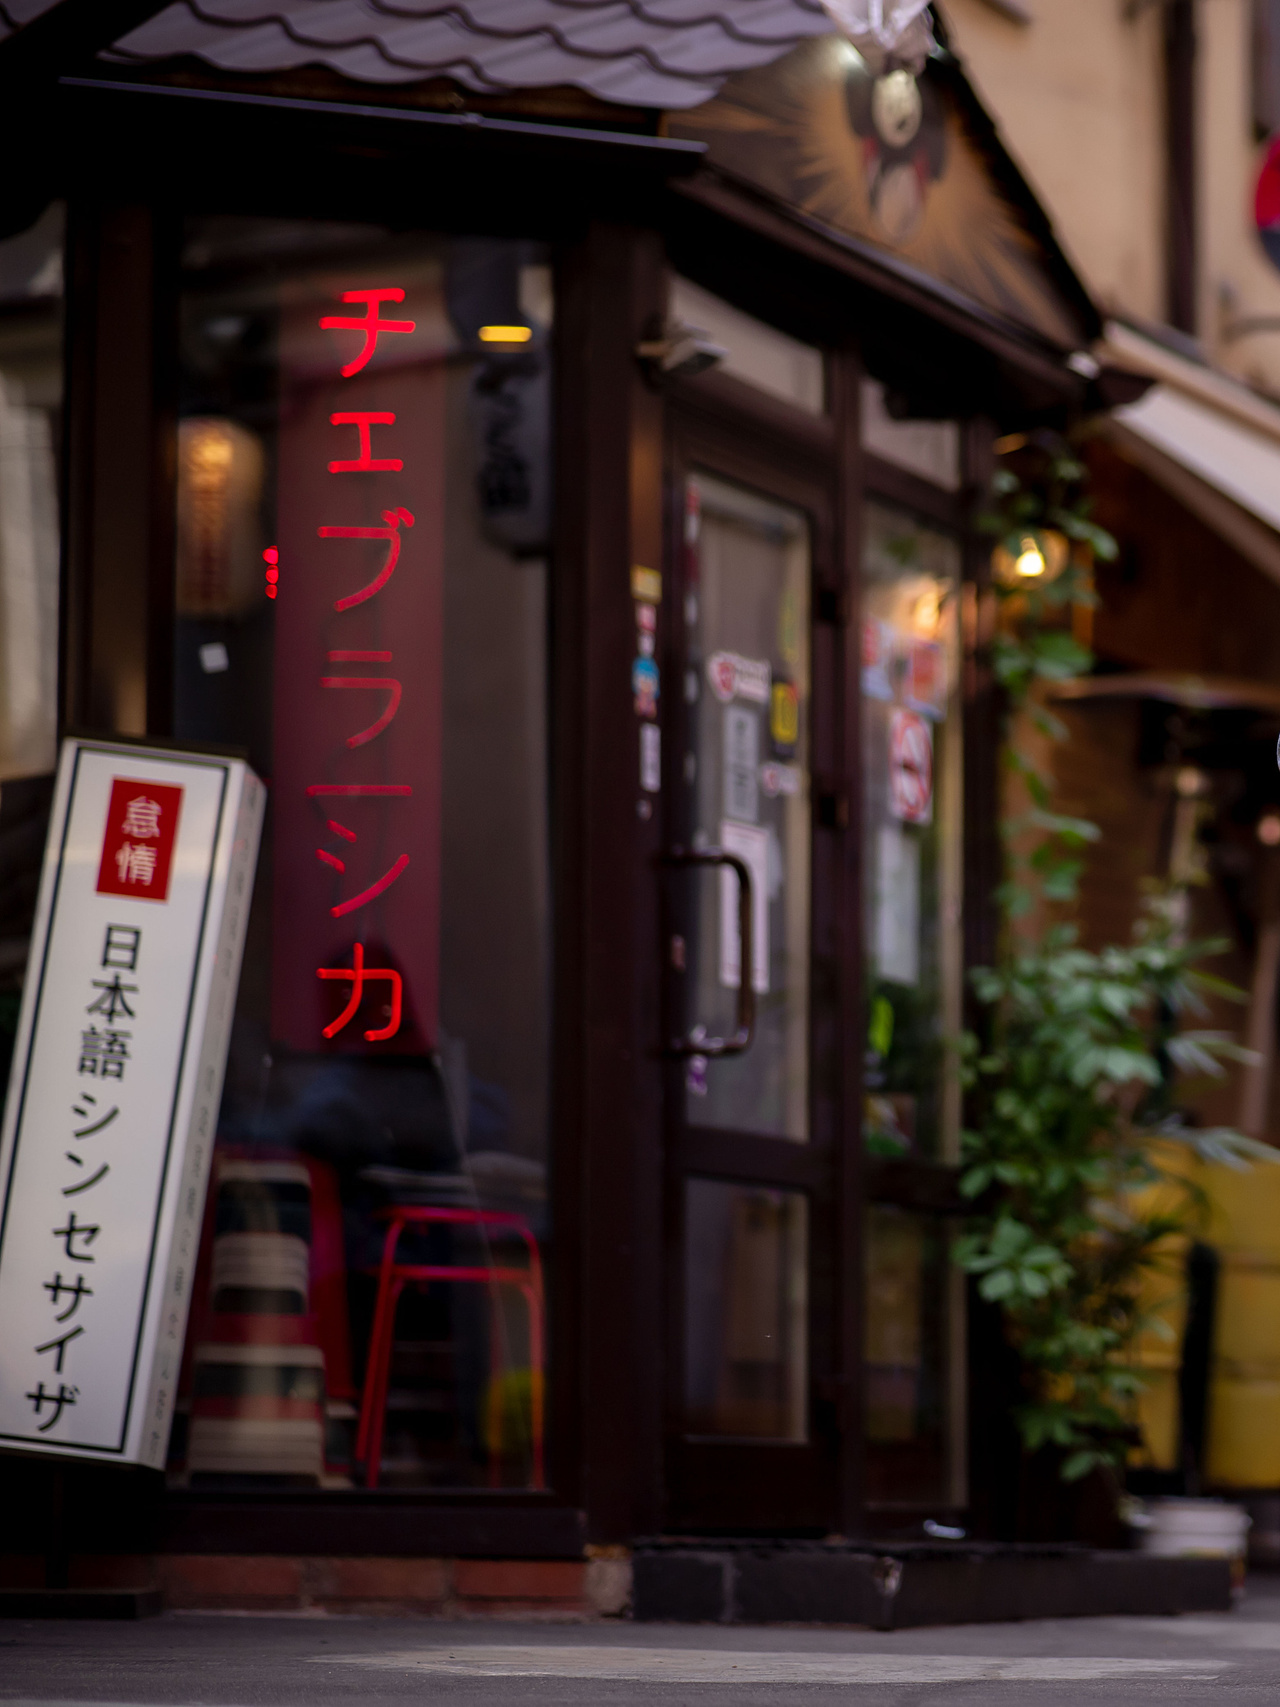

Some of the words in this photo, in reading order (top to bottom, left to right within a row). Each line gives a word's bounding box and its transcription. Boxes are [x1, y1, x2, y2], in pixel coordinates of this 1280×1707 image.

[26, 922, 142, 1432] 日本語シンセサイザ
